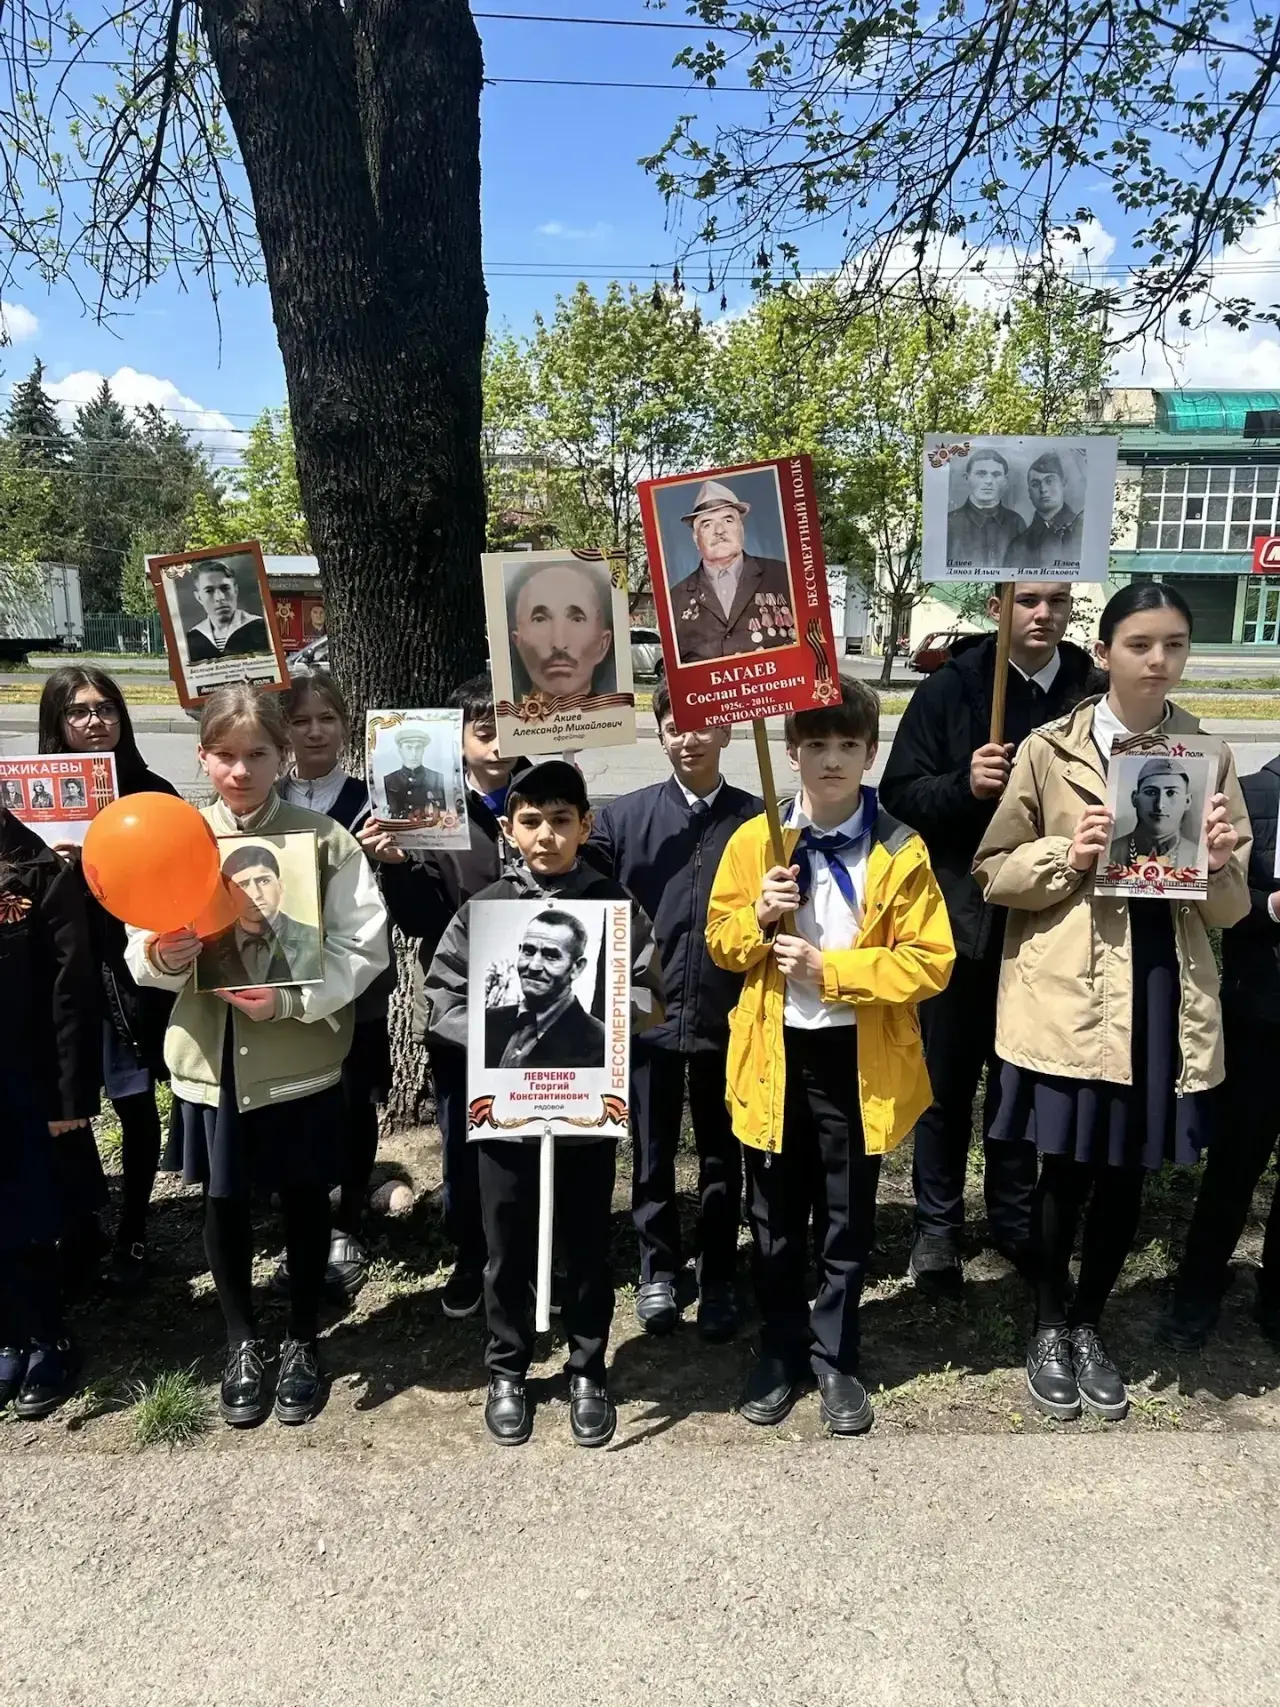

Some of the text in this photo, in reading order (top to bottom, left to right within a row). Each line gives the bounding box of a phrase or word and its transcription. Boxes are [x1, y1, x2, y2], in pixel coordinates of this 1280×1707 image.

[790, 459, 819, 607] БЕССМЕРТНЫЙ ПОЛК
[710, 661, 777, 686] БАГАЕВ
[686, 675, 806, 706] Сослан Бетоевич
[720, 702, 744, 712] 1925г.
[751, 696, 776, 707] 2011г.
[554, 713, 582, 722] Акиев
[705, 701, 795, 726] КРАСНОАРМЕЕЦ
[513, 720, 623, 737] Александр Михайлович
[610, 906, 627, 1089] БЕССМЕРТНЫЙ ПОЛК
[524, 1071, 576, 1081] ЛЕВЧЕНКО
[530, 1081, 570, 1092] Георгий
[510, 1092, 590, 1101] Константинович
